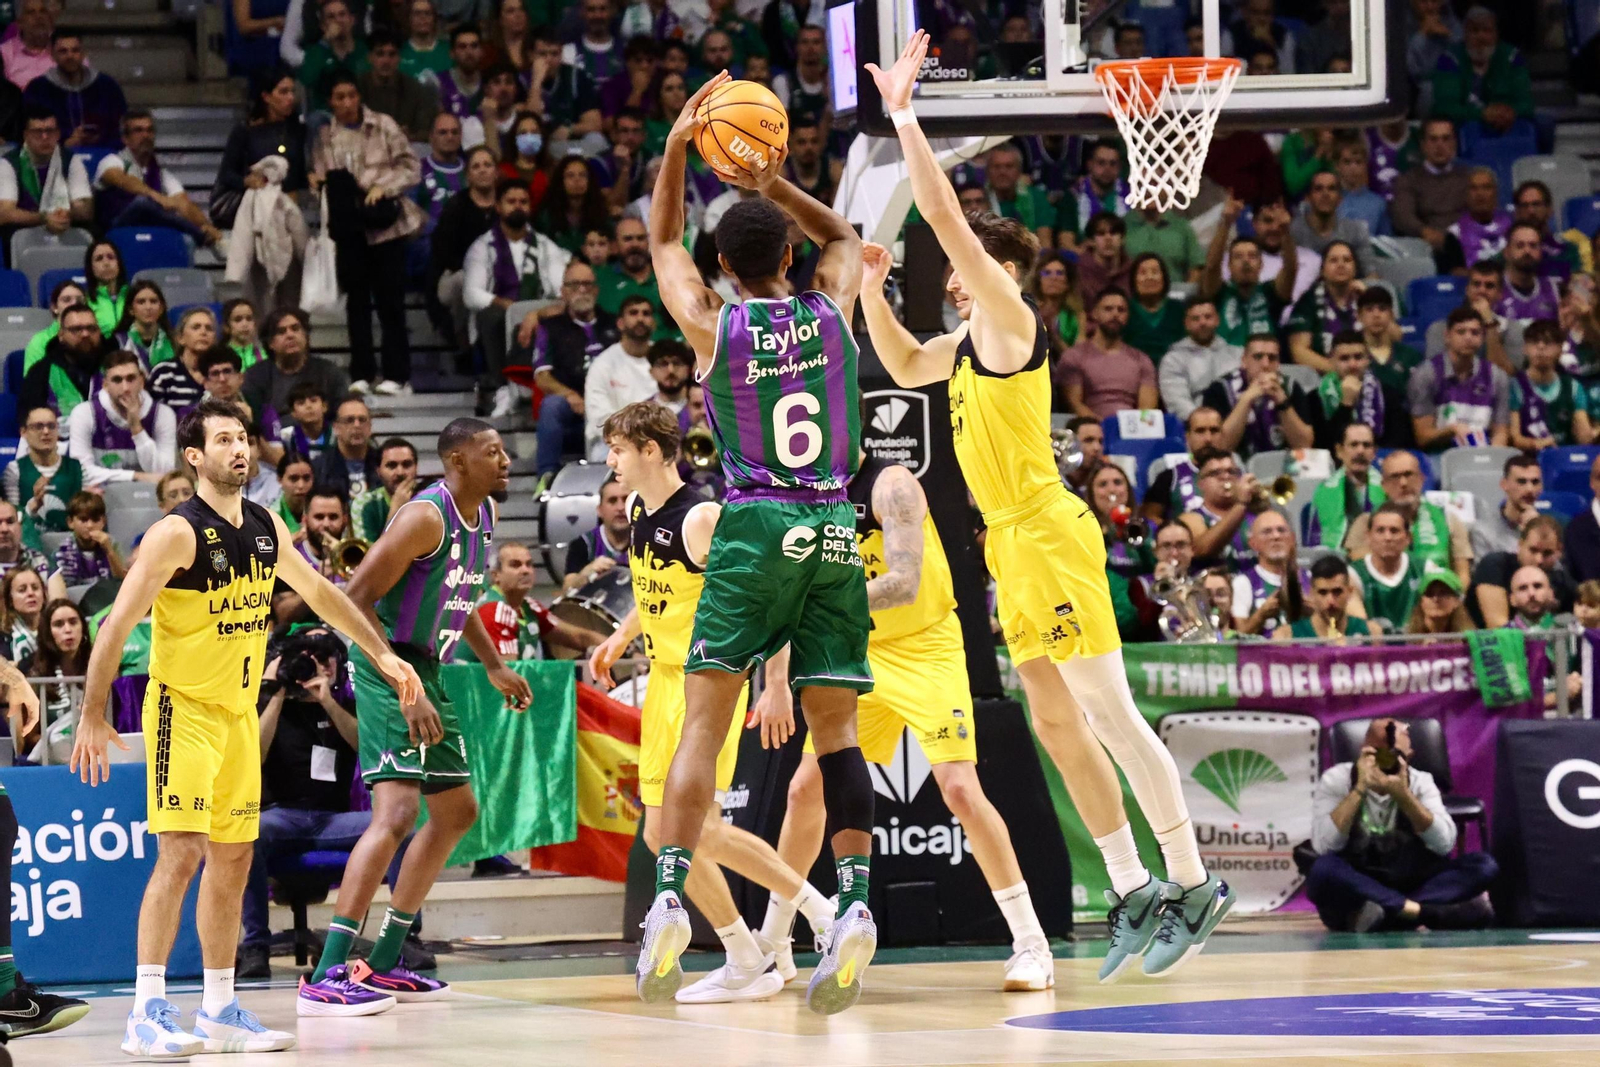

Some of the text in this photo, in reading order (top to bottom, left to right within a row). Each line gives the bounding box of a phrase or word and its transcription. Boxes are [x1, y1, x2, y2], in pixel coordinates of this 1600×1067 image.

[760, 119, 780, 135] acb
[746, 318, 821, 355] Taylor
[745, 353, 829, 385] Benahavís
[773, 391, 823, 469] 6
[864, 436, 918, 448] Fundación
[821, 551, 865, 568] MÁLAGA
[822, 539, 848, 551] DEL
[458, 571, 485, 585] Unica
[209, 592, 270, 614] LA LAGUN
[242, 656, 251, 689] 6
[1142, 662, 1264, 698] TEMPLO
[1269, 663, 1326, 697] DEL
[1330, 656, 1478, 696] BALONCE
[11, 808, 160, 866] ación
[872, 816, 974, 866] nicaj
[1196, 823, 1290, 851] Unicaja
